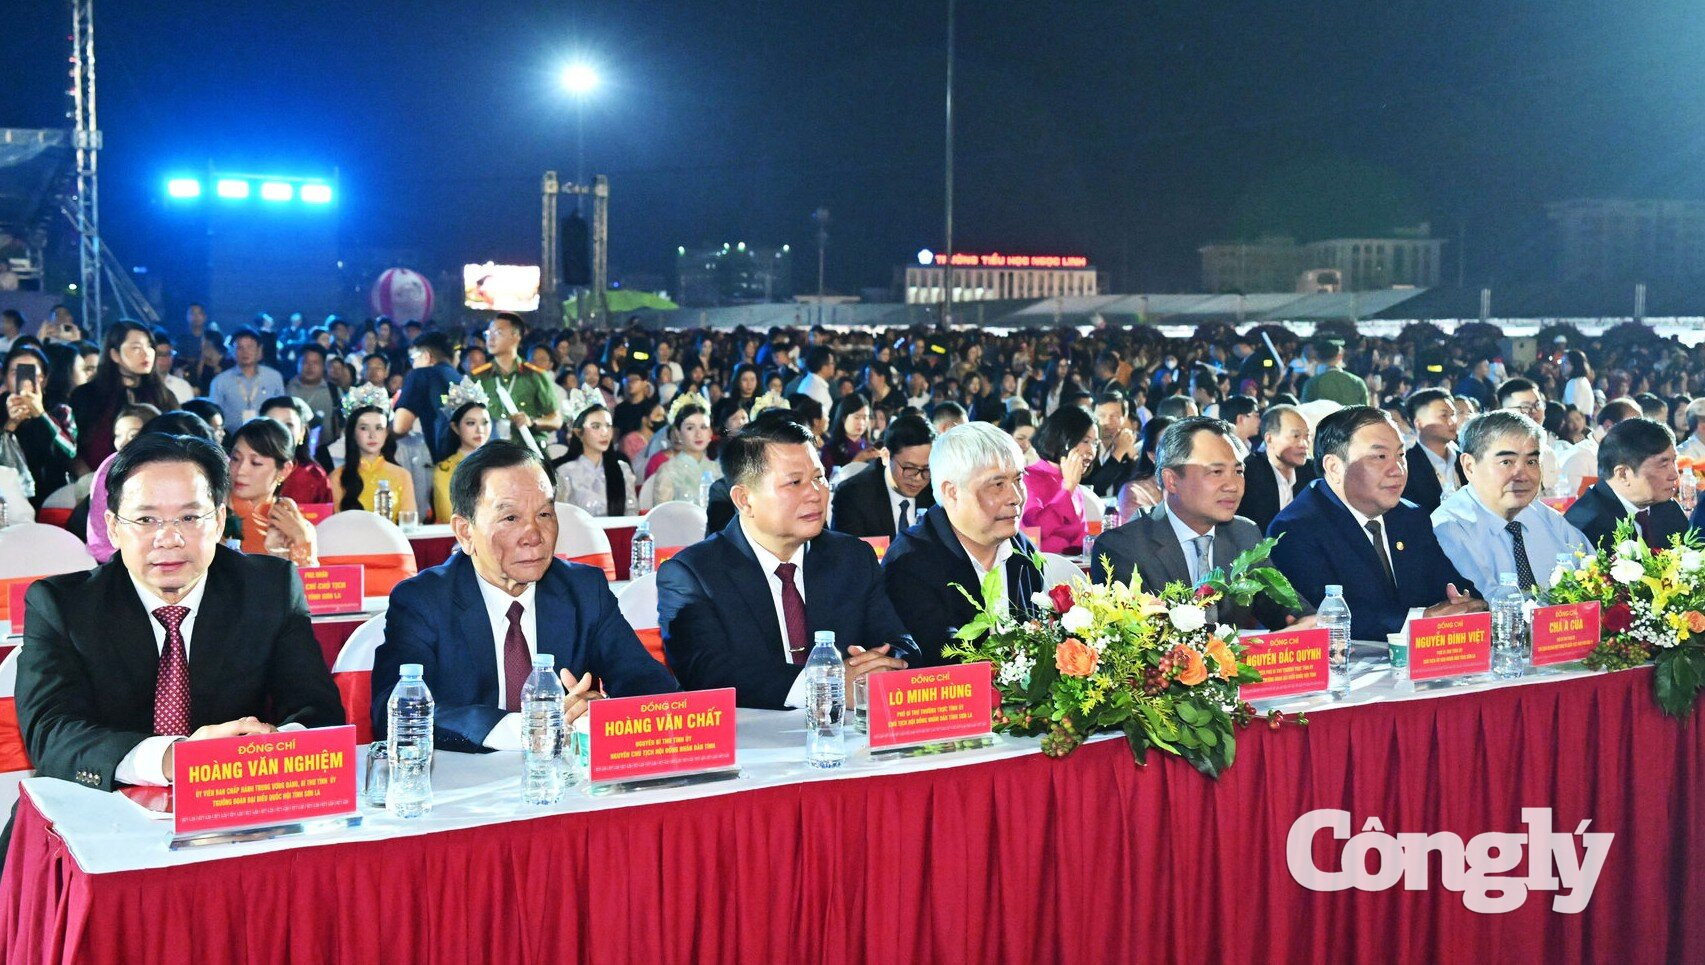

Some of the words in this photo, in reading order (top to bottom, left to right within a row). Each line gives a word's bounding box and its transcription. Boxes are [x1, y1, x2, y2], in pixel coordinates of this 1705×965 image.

[1416, 631, 1445, 649] NGUYỄN
[1448, 631, 1466, 644] ĐÌNH
[1468, 628, 1484, 644] VIỆT
[1247, 648, 1276, 667] NGUYỄN
[1279, 648, 1294, 663] ĐẮC
[1296, 646, 1321, 662] QUỲNH
[889, 688, 903, 706] LÒ
[908, 688, 937, 703] MINH
[941, 683, 972, 699] HÙNG
[605, 716, 651, 736] HOÀNG
[656, 713, 682, 731] VĂN
[687, 706, 722, 728] CHẤT
[189, 760, 243, 783] HOÀNG
[248, 756, 278, 777] VĂN
[284, 749, 343, 773] NGHIỆM
